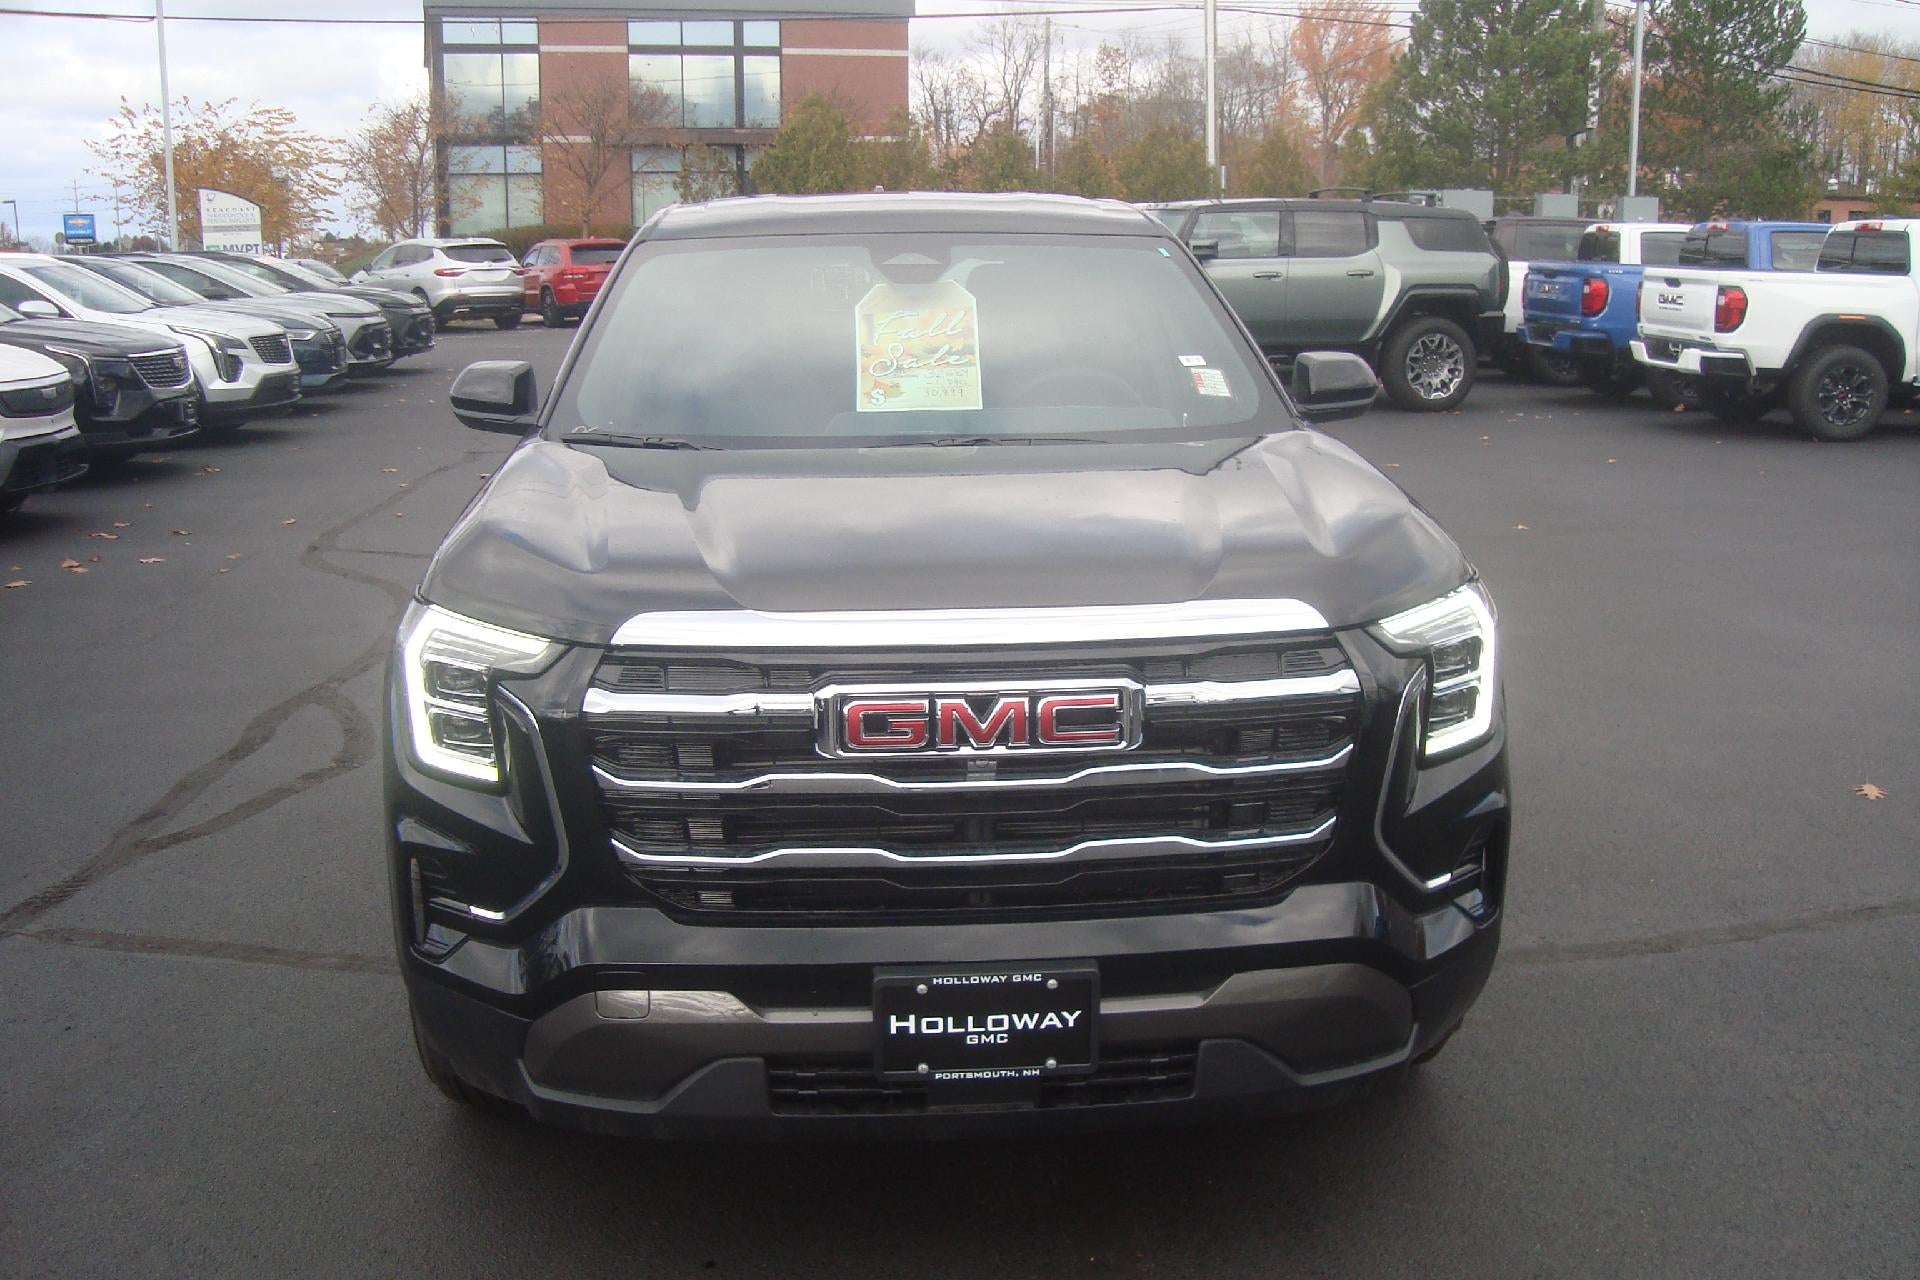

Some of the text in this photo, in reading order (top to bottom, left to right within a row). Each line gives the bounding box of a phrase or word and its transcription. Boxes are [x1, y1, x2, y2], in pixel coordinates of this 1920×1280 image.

[873, 310, 966, 346] Fall
[869, 342, 969, 378] Sale
[870, 388, 887, 406] $
[844, 694, 1119, 750] GMC
[932, 973, 1043, 985] HOLLOWAY GMC
[889, 1010, 1082, 1035] HOLLOWAY
[966, 1033, 1009, 1045] GMC
[1022, 1068, 1040, 1077] NH
